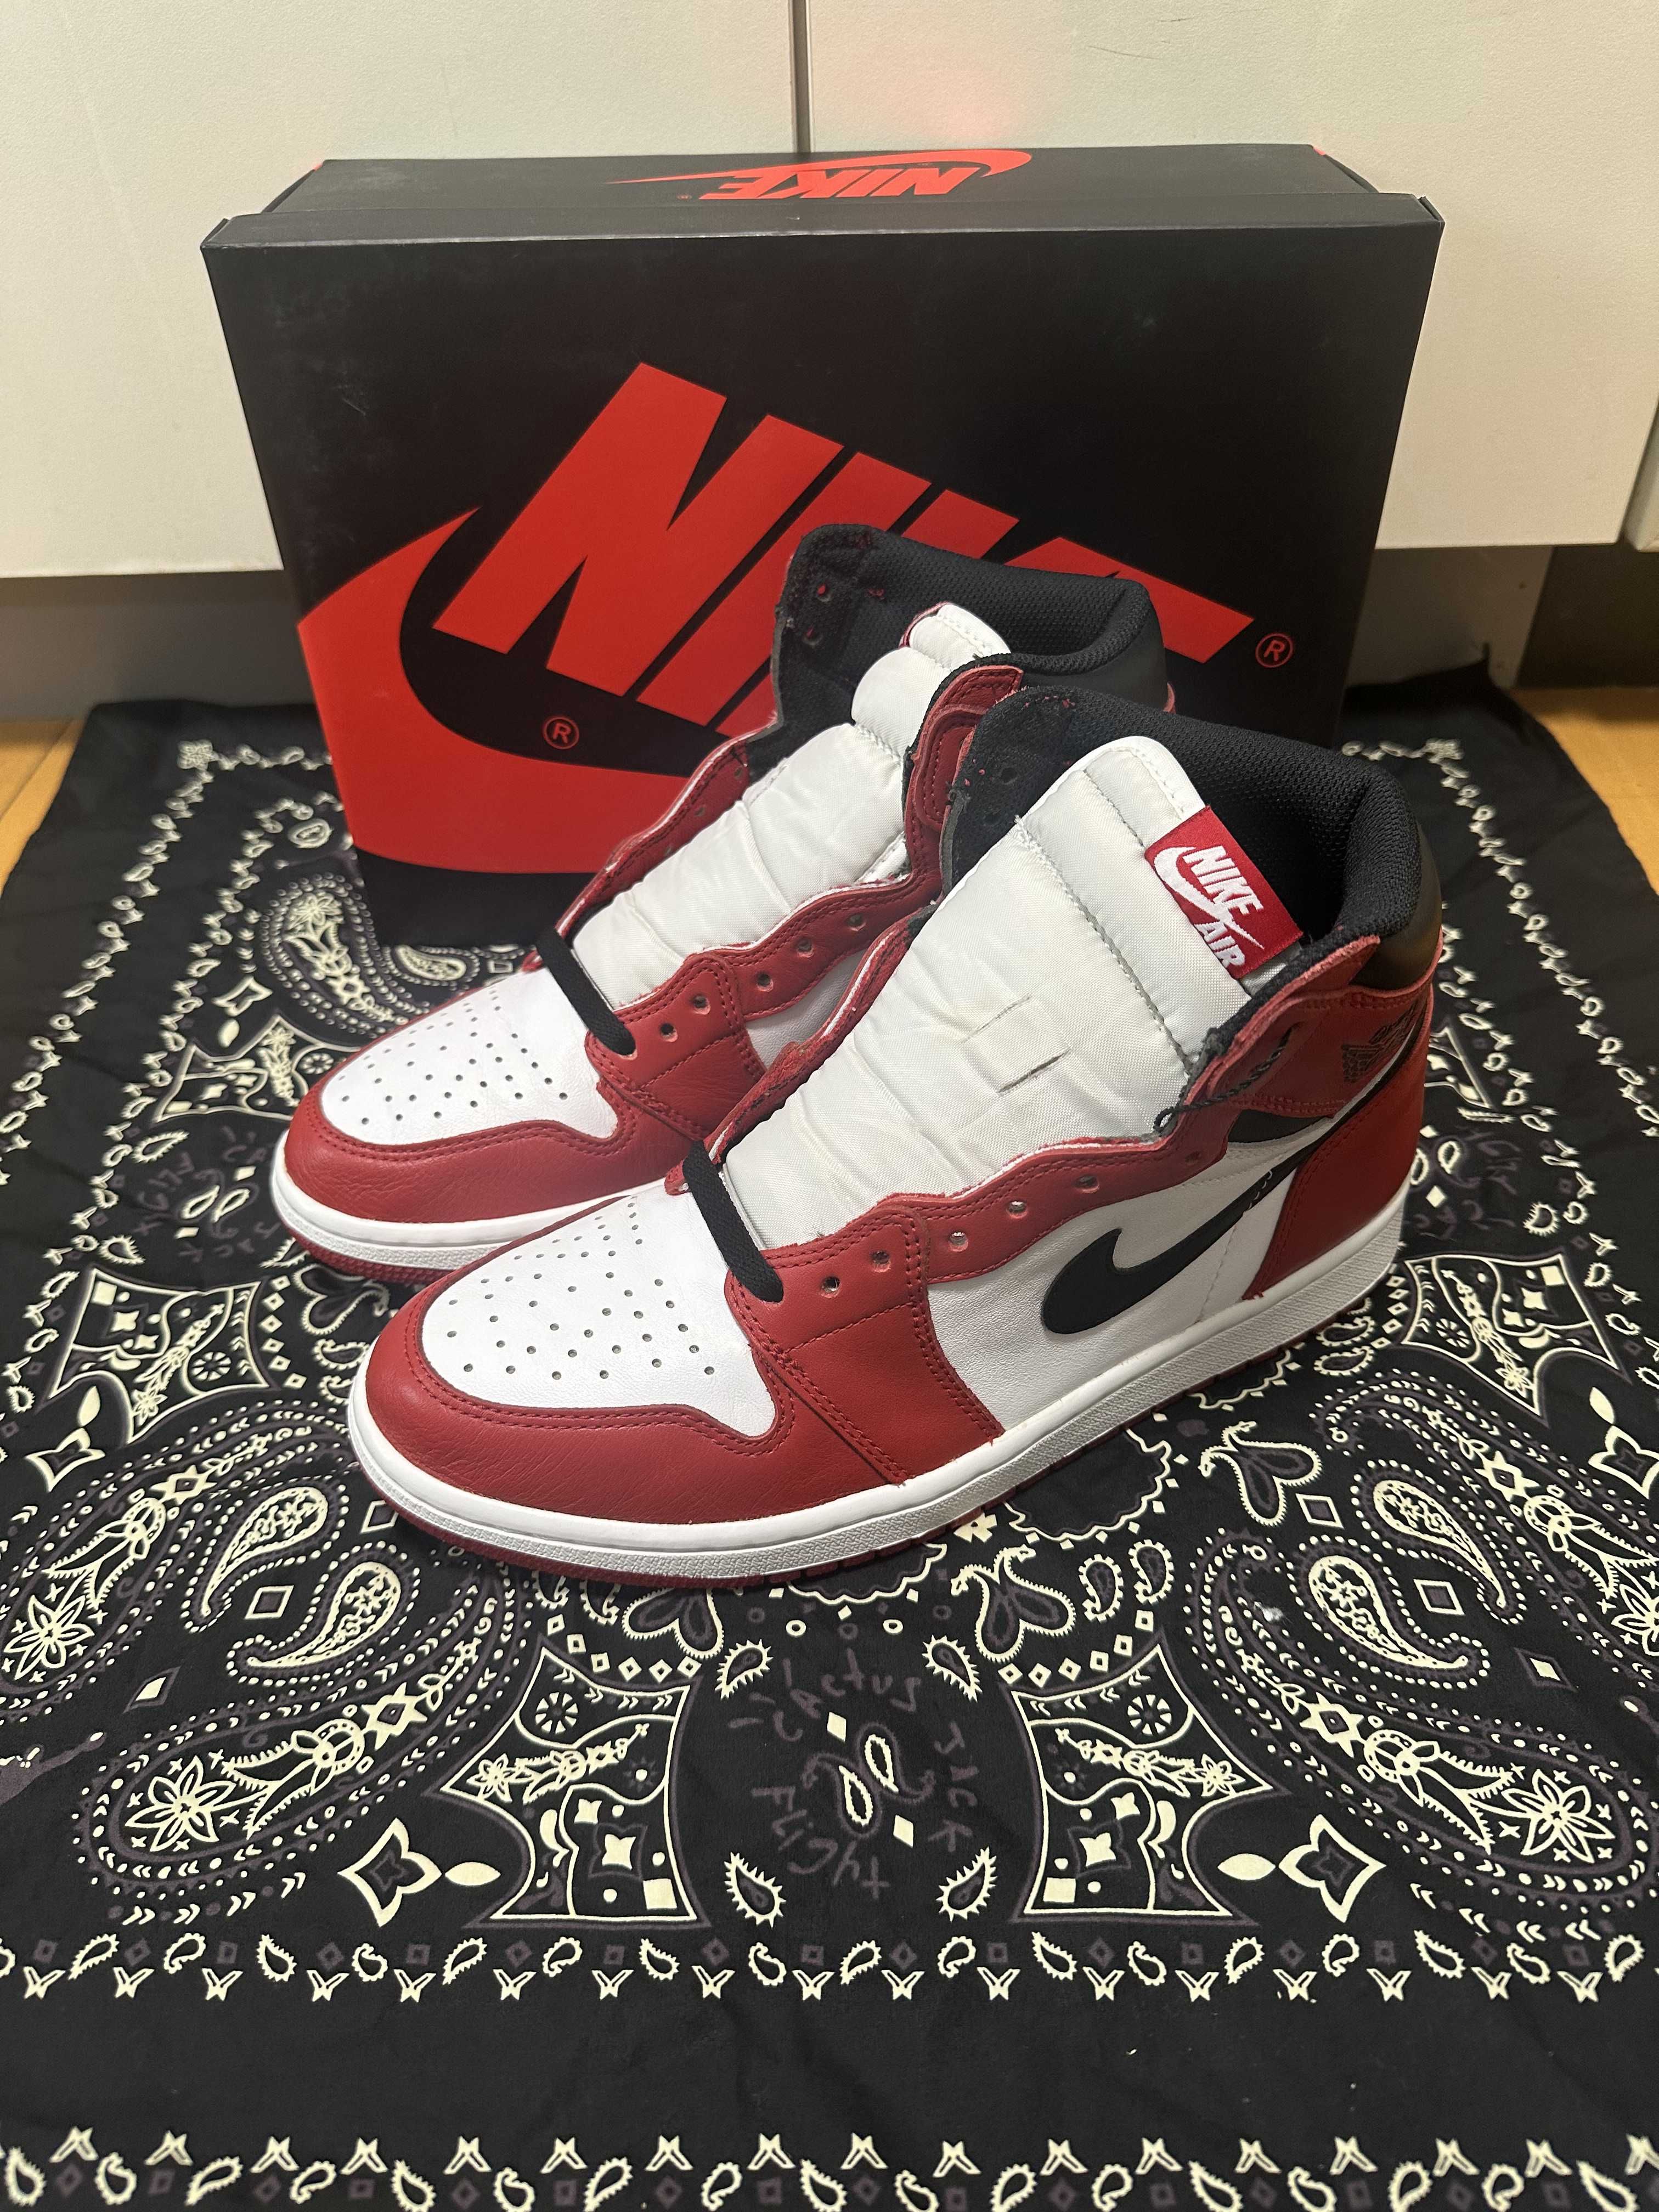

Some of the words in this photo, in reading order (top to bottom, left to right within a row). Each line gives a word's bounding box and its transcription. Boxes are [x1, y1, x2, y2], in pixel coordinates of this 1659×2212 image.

[698, 168, 981, 199] NIKE
[1182, 845, 1264, 915] NIKE
[1193, 922, 1245, 968] AIR
